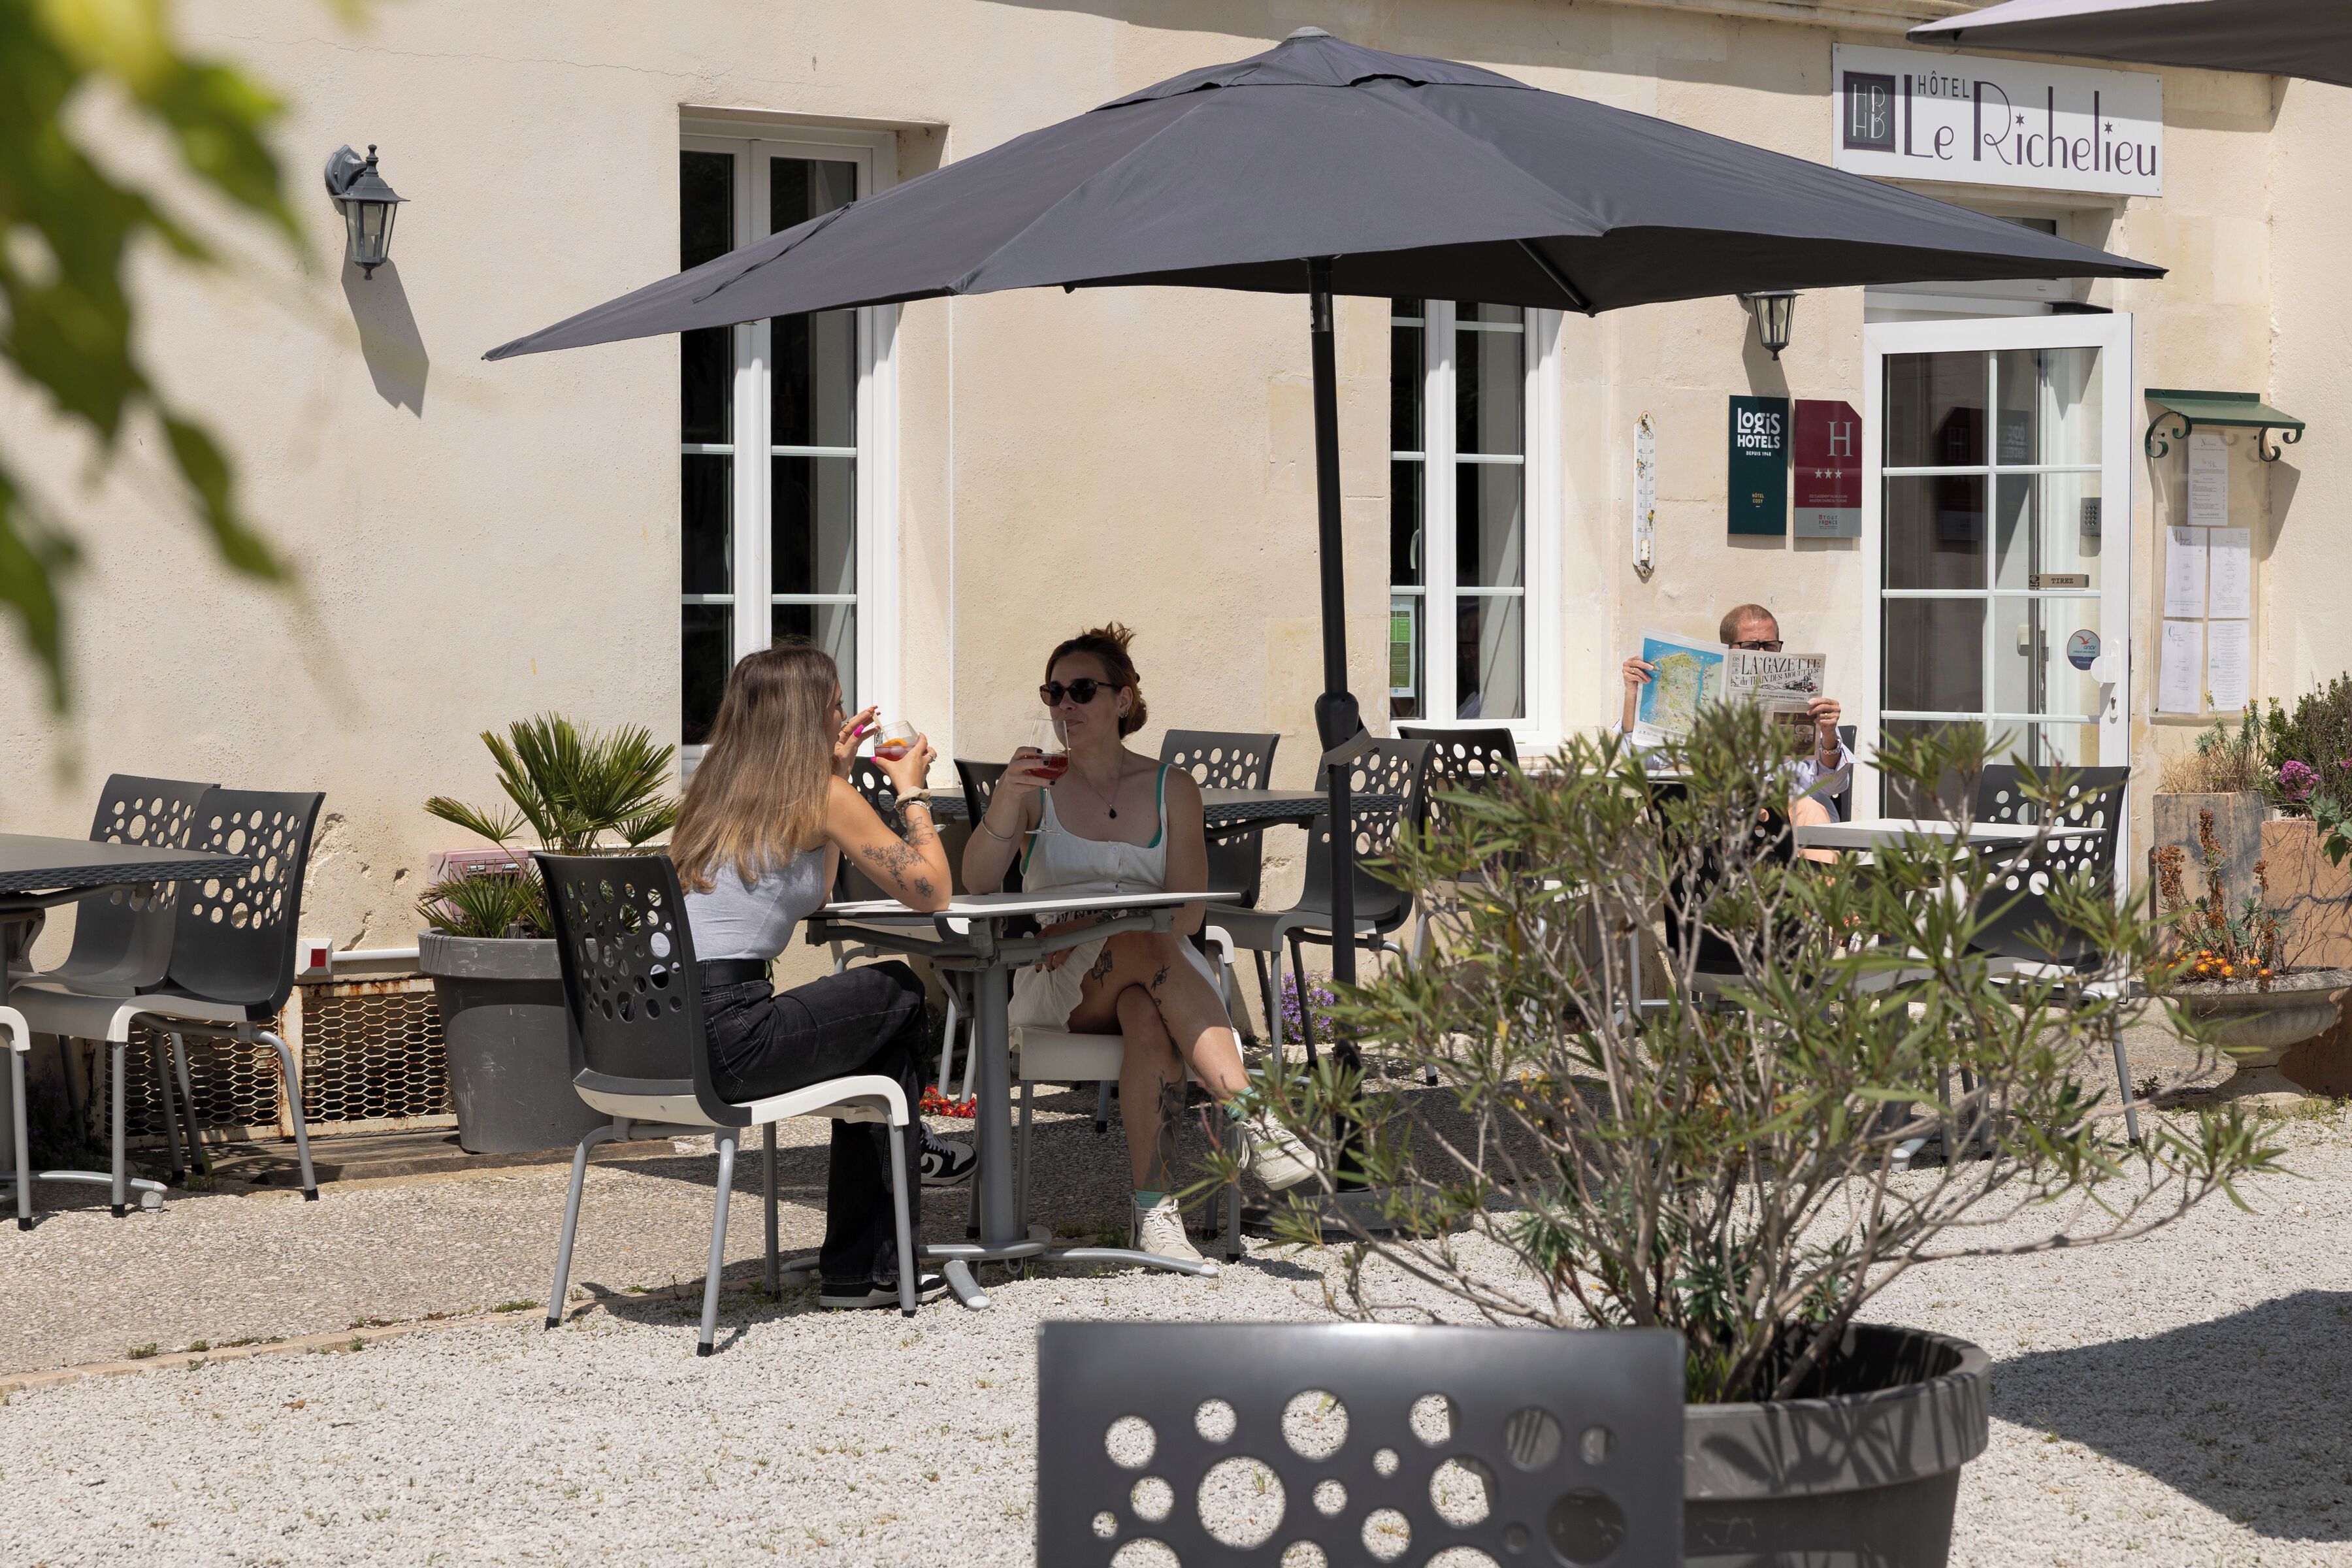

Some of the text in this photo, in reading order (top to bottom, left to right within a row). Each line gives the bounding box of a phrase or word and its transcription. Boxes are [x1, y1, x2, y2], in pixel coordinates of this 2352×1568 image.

[1918, 71, 1970, 98] HÔTEL
[1903, 74, 2156, 176] Le Richelieu
[1737, 434, 1780, 449] HOTELS
[1827, 421, 1854, 457] H
[1763, 656, 1821, 674] GAZETTE
